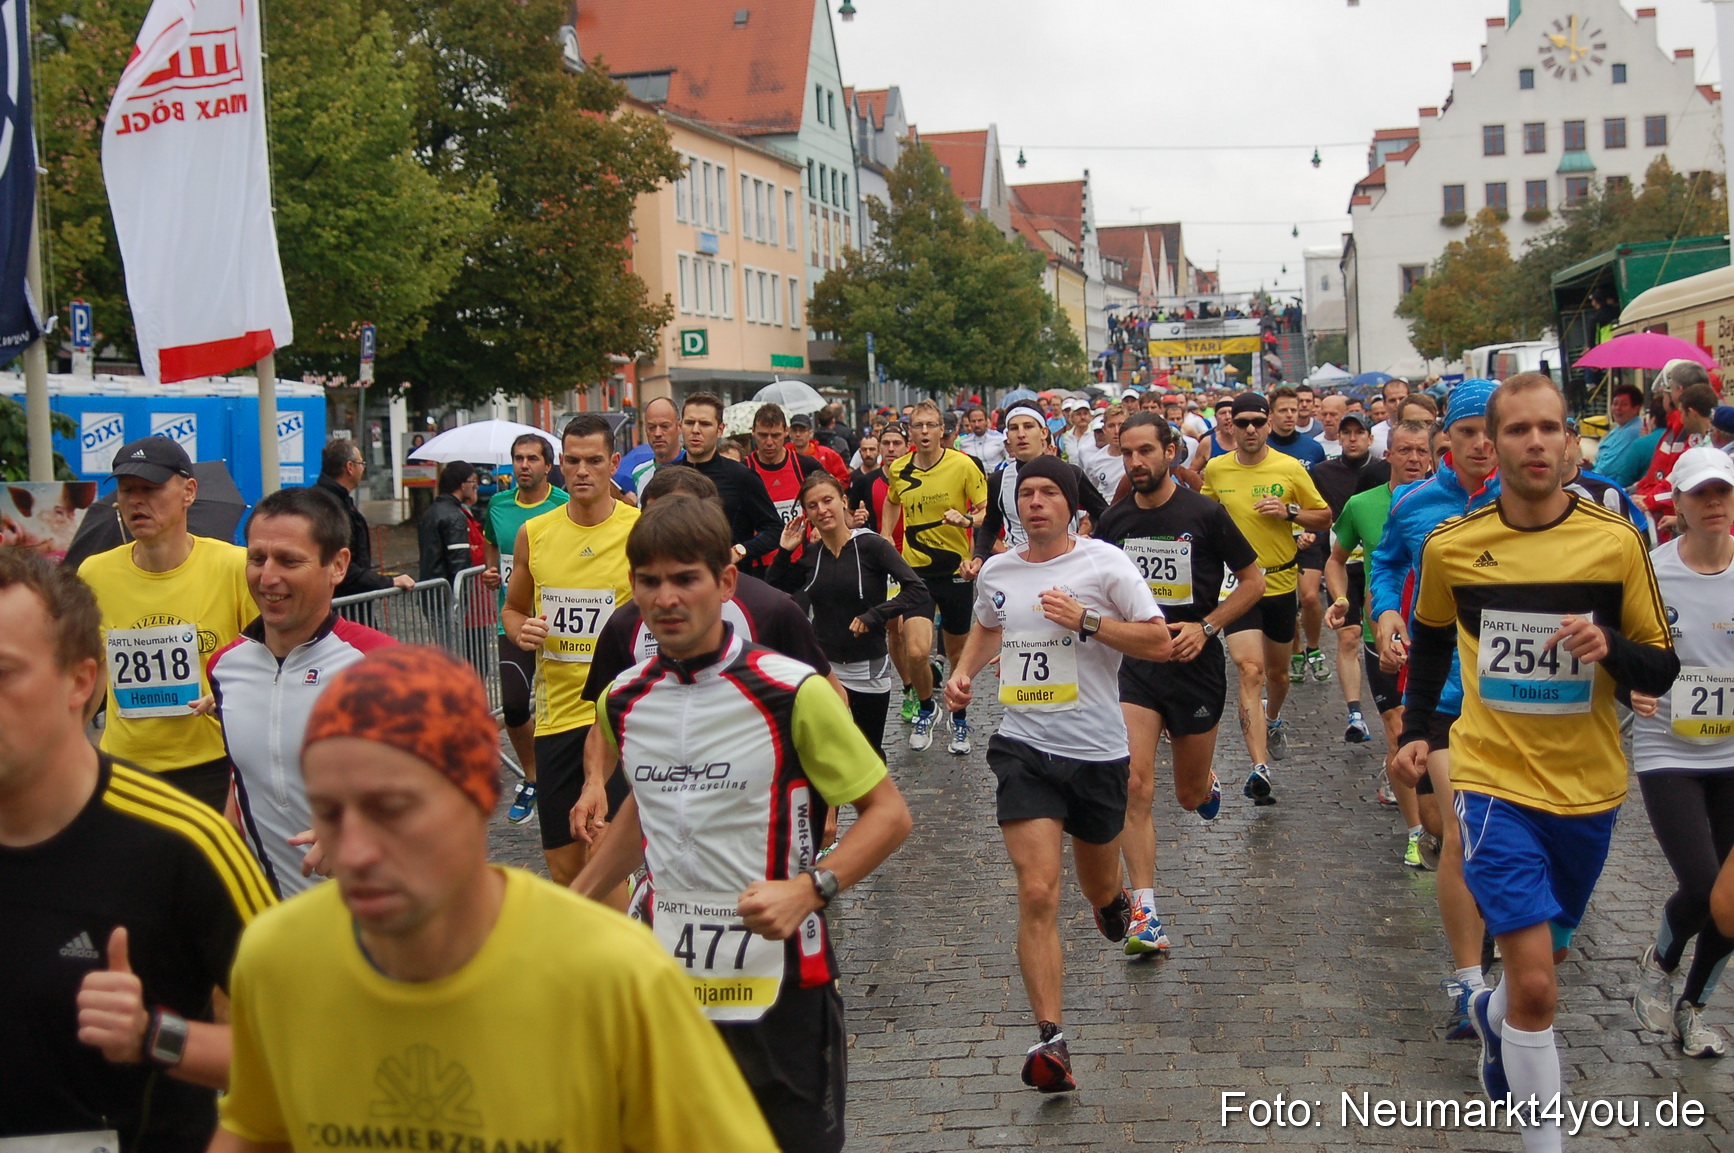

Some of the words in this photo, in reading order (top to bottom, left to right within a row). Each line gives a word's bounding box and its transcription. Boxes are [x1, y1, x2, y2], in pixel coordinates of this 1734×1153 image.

[683, 332, 704, 353] D
[1185, 342, 1223, 352] START
[277, 416, 302, 437] IXI
[1125, 545, 1145, 553] PARTL
[1147, 547, 1178, 555] Neumarkt
[1137, 556, 1177, 581] 325
[543, 594, 562, 603] PARTL
[565, 596, 602, 604] Neumarkt
[1150, 587, 1172, 597] scha
[554, 607, 600, 634] 457
[1483, 620, 1518, 632] PARTL
[1522, 623, 1560, 634] Neuma
[108, 638, 132, 647] PARTL
[134, 635, 178, 646] Neumarkt
[560, 640, 591, 652] Marco
[1021, 639, 1058, 648] Neumarkt
[1489, 636, 1580, 676] 2541
[115, 647, 190, 684] 2818
[1019, 652, 1050, 682] 73
[1675, 675, 1704, 683] PARTL
[131, 691, 178, 706] Henning
[1017, 689, 1054, 702] Gunder
[1510, 684, 1559, 700] Tobias
[1700, 723, 1731, 735] Anika
[700, 780, 748, 791] cycling
[657, 901, 691, 915] PARTL
[694, 905, 738, 917] Neuma
[60, 948, 99, 959] adidas
[674, 923, 753, 970] 477
[694, 983, 753, 1005] njamin
